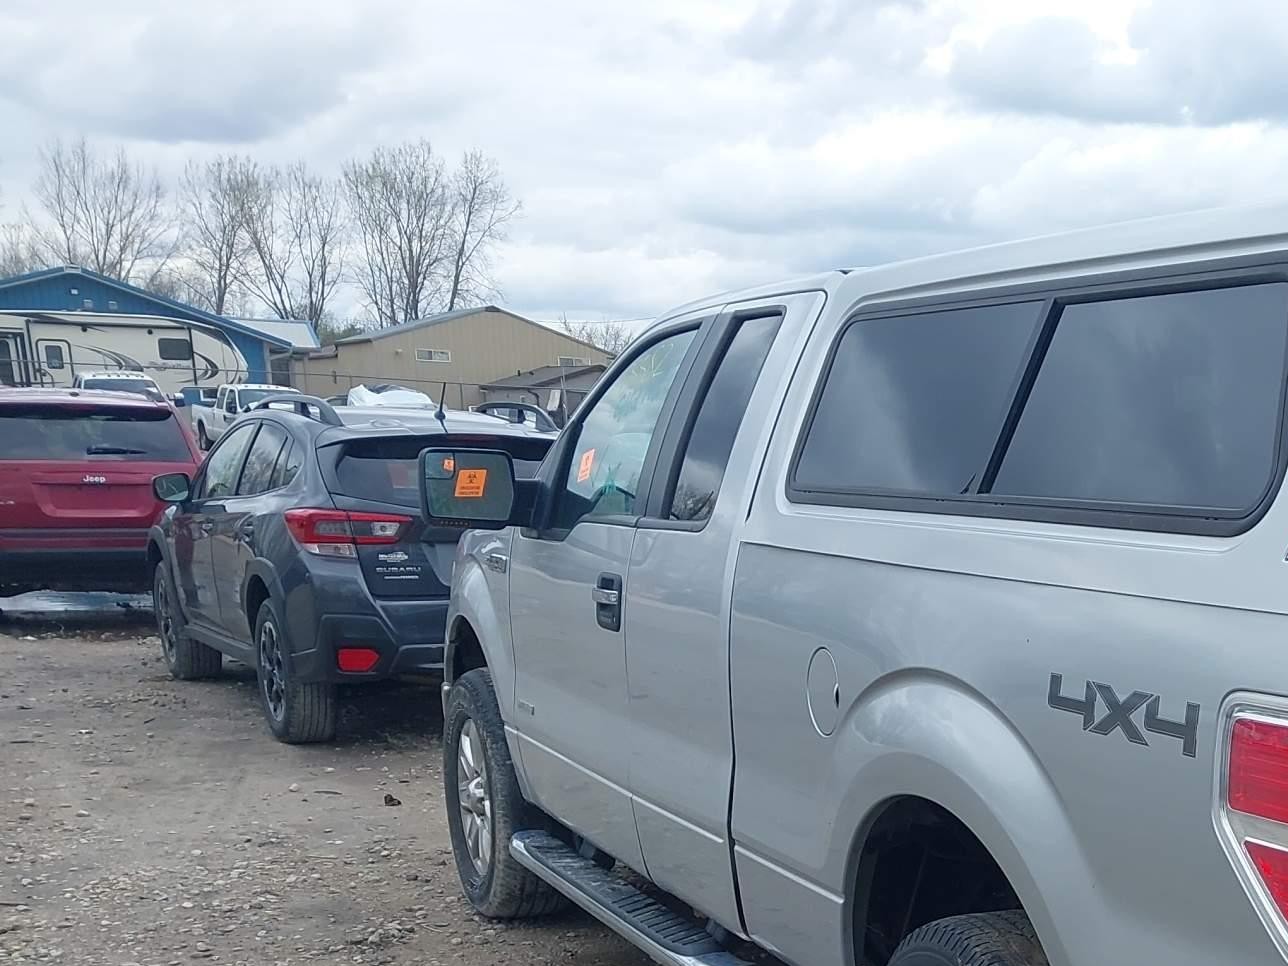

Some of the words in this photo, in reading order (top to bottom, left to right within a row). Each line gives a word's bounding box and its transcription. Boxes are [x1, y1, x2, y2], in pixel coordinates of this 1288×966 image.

[83, 474, 106, 484] Jeep
[375, 566, 422, 574] SUBARU
[1047, 672, 1200, 758] 4X4
